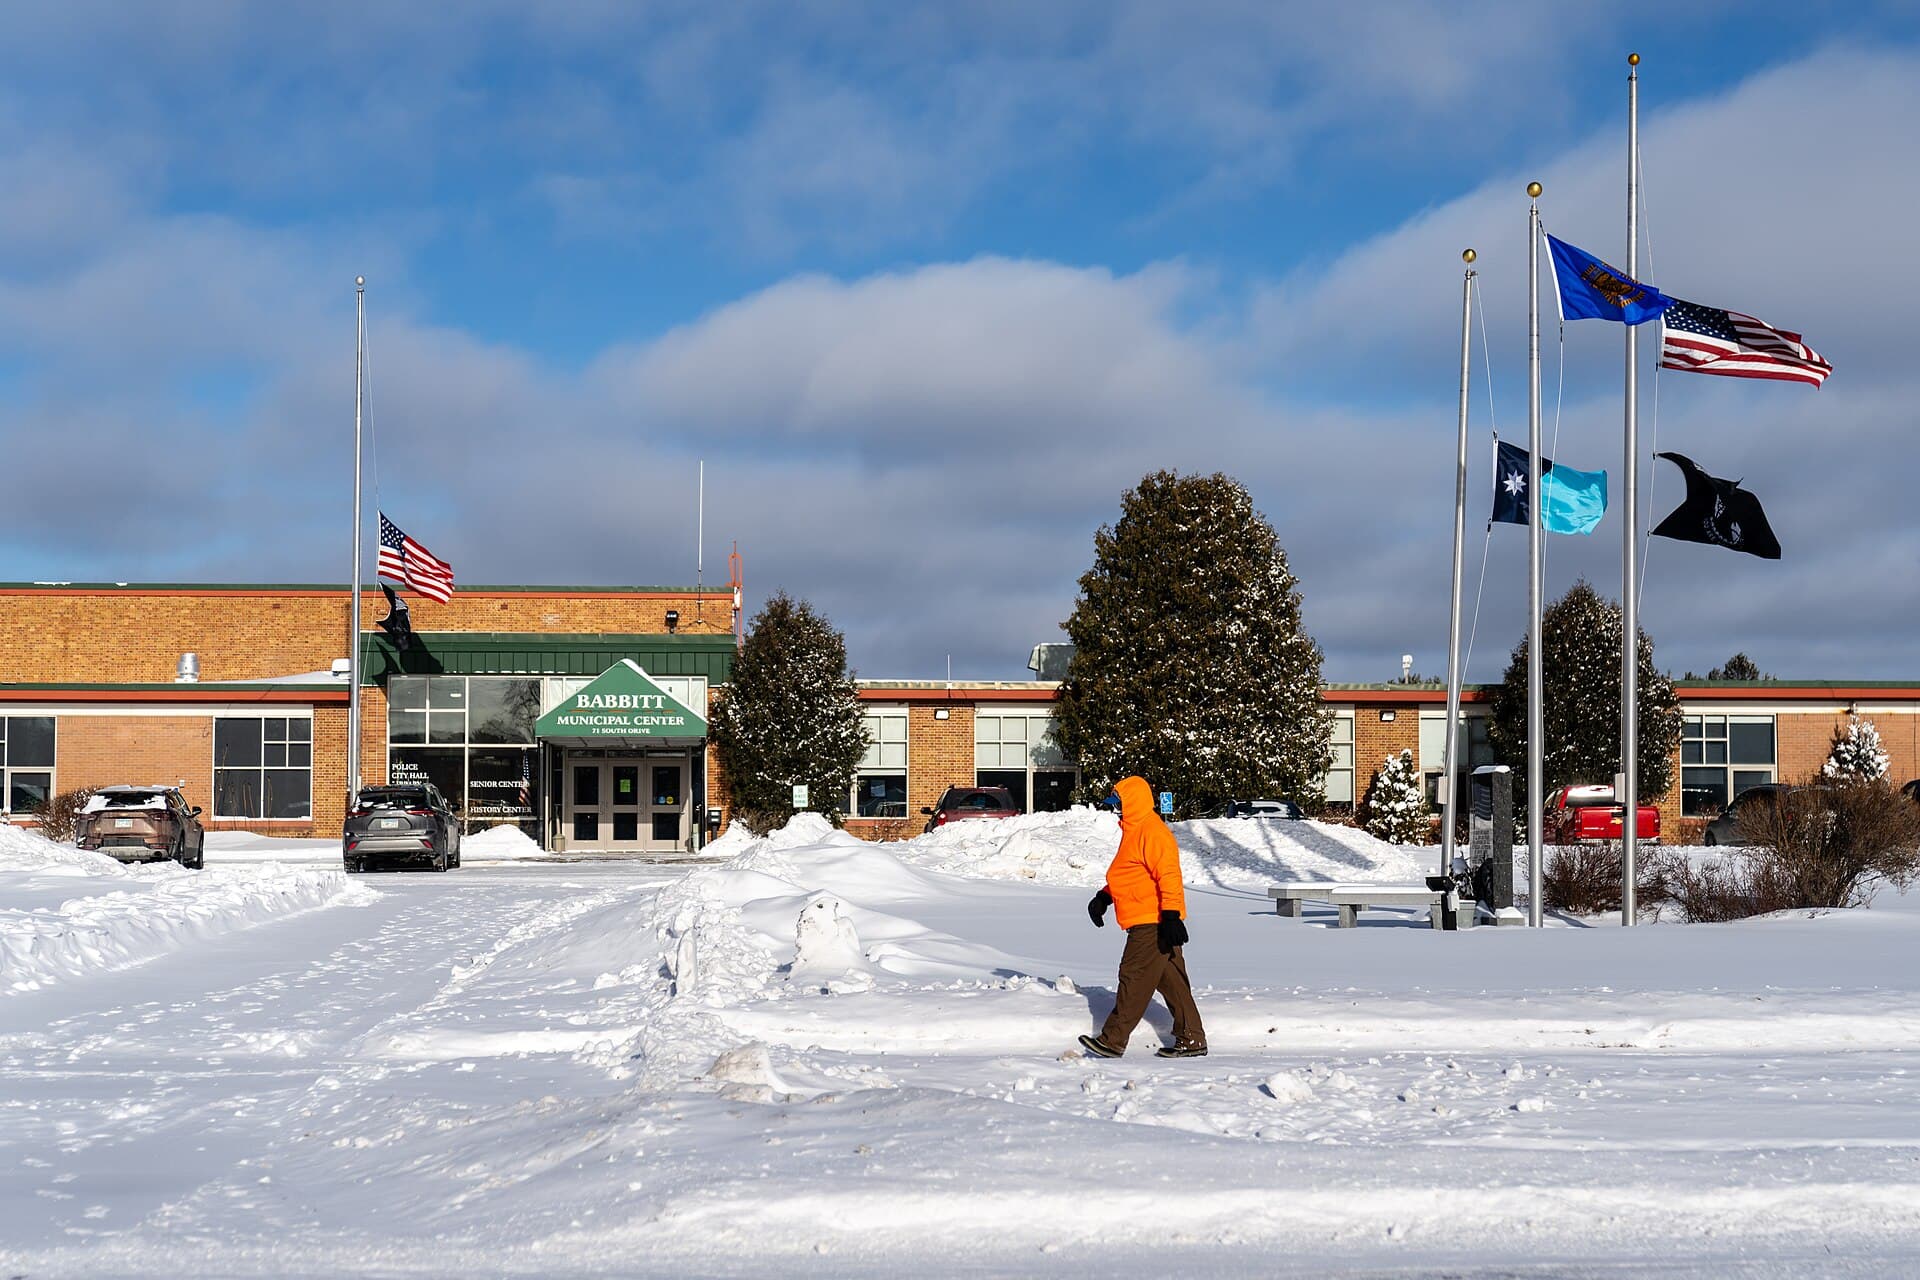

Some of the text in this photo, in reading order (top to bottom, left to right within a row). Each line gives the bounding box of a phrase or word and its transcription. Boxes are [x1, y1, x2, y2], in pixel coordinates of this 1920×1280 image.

[577, 694, 666, 709] BABBITT
[557, 715, 685, 726] MUNICIPAL CENTER
[391, 763, 419, 771] POLICE
[470, 780, 498, 788] SENIOR
